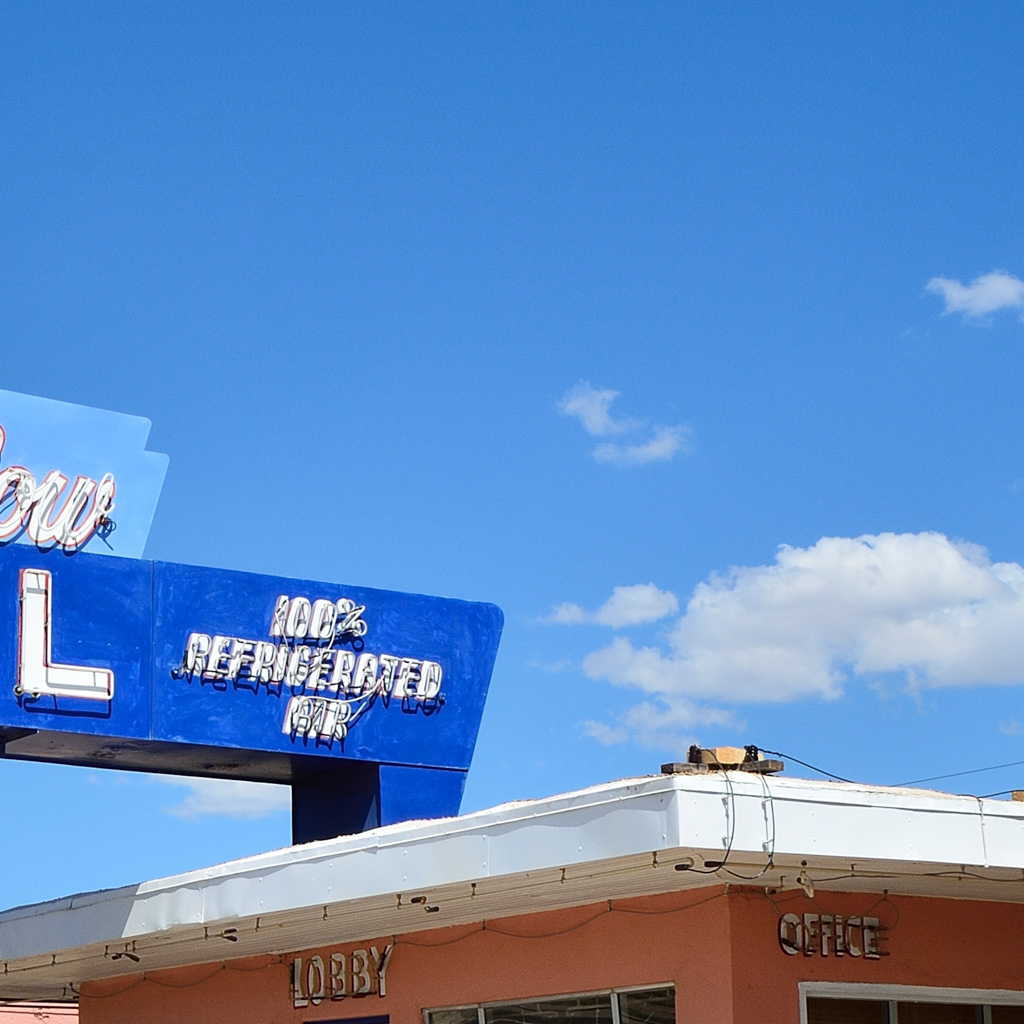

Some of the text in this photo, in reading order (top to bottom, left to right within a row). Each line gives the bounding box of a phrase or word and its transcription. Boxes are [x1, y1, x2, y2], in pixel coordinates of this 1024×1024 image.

[269, 595, 367, 639] 100%
[182, 632, 443, 701] REFRIGERATED
[282, 696, 352, 741] AIR
[778, 913, 882, 959] OFFICE
[292, 944, 393, 1009] LOBBY
